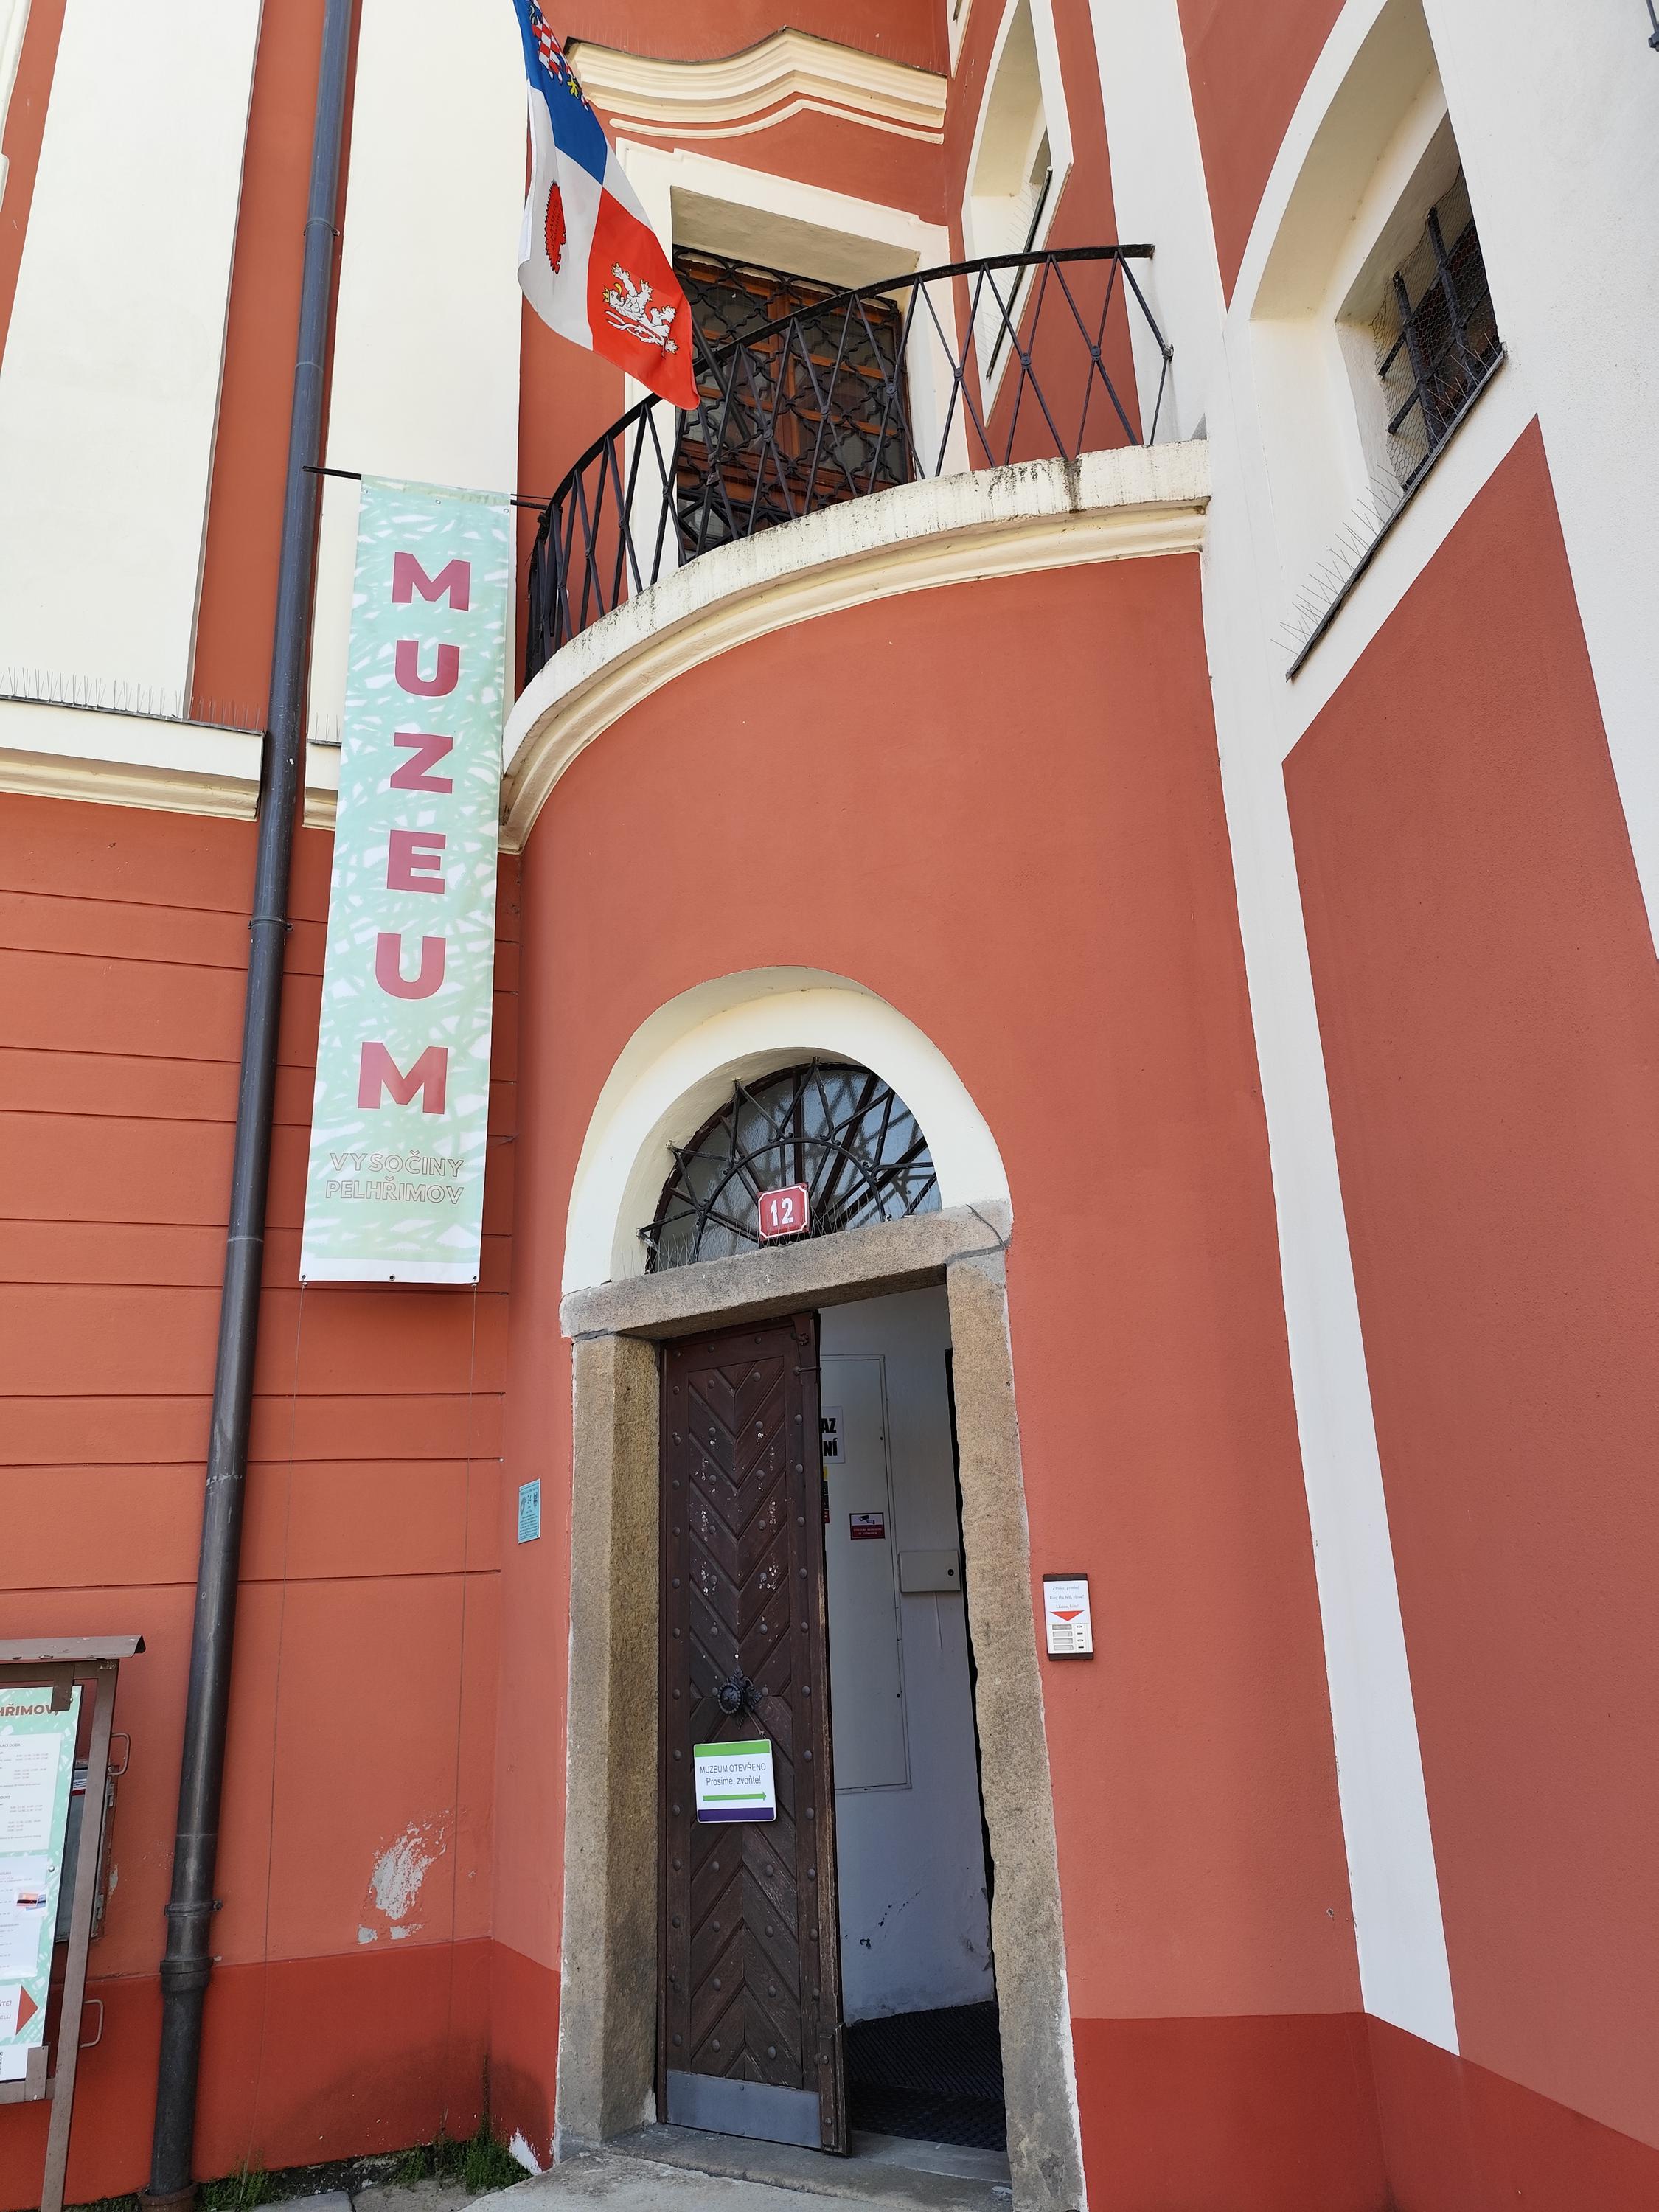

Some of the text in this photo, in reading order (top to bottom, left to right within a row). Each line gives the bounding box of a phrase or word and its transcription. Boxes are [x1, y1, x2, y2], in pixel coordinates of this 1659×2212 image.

[358, 552, 470, 1115] MUZEUM
[330, 1150, 465, 1178] VYSOČINY
[326, 1176, 465, 1204] PELHŘIMOV
[771, 1197, 793, 1226] 12
[700, 1762, 766, 1774] MUZEUM OTEVŘENO
